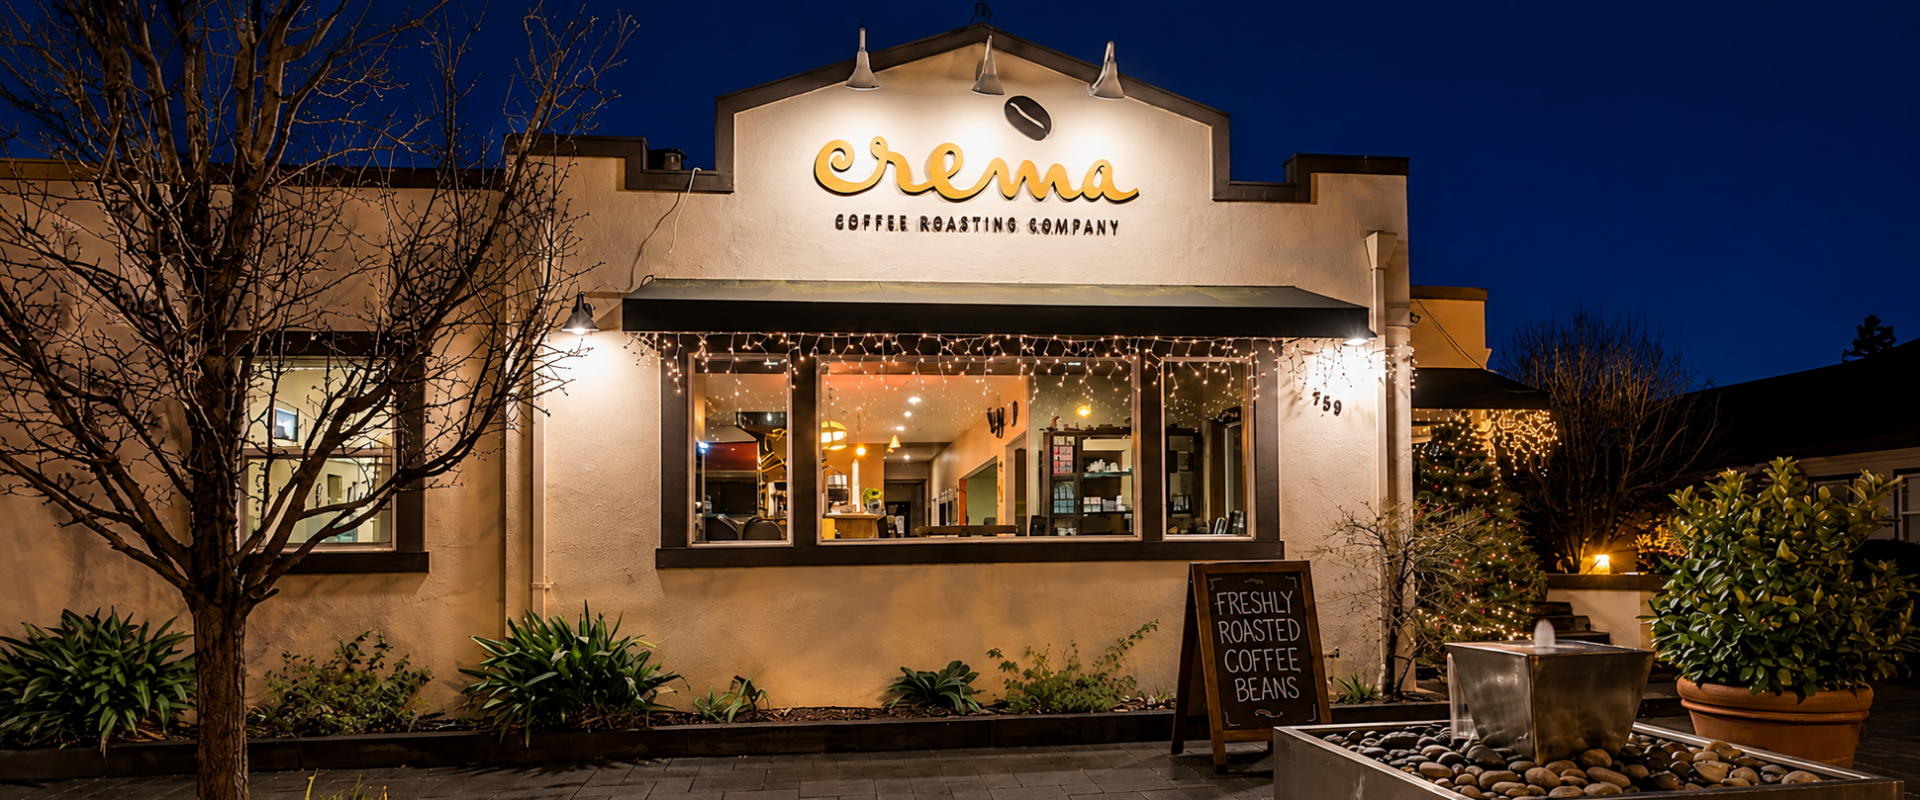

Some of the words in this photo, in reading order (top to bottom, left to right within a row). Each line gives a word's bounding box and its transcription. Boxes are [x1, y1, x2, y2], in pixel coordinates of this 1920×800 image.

[835, 214, 908, 232] COFFEE
[920, 216, 1016, 234] ROASTING
[1029, 218, 1120, 236] COMPANY
[1312, 391, 1342, 417] 759
[1215, 590, 1293, 615] FRESHLY
[1218, 618, 1301, 644] ROASTED
[1224, 647, 1301, 673] COFFEE
[1234, 676, 1300, 702] BEANS
